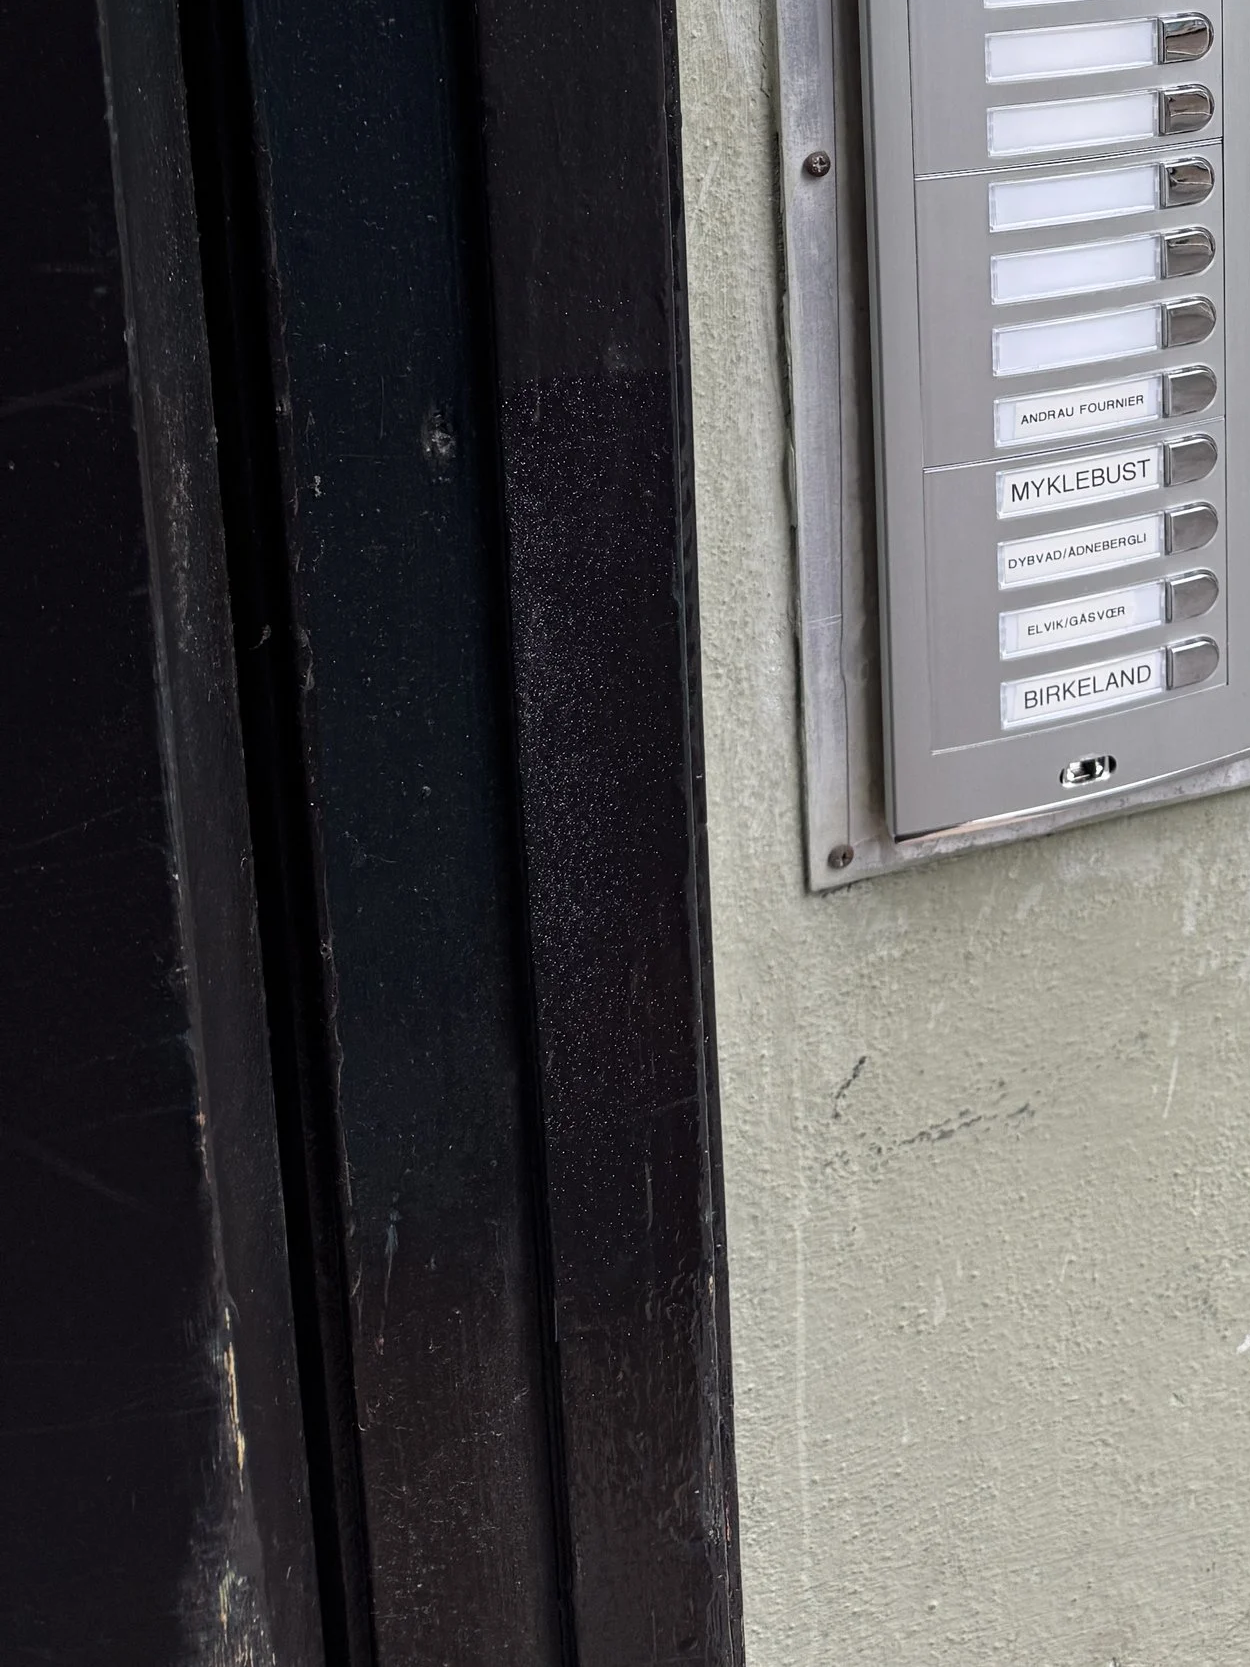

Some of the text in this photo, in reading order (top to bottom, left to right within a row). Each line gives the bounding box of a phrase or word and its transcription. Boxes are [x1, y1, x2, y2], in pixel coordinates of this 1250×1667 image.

[1020, 394, 1144, 425] ANDRAU FOURNIER
[1011, 459, 1151, 503] MYKLEBUST
[1023, 663, 1152, 709] BIRKELAND
